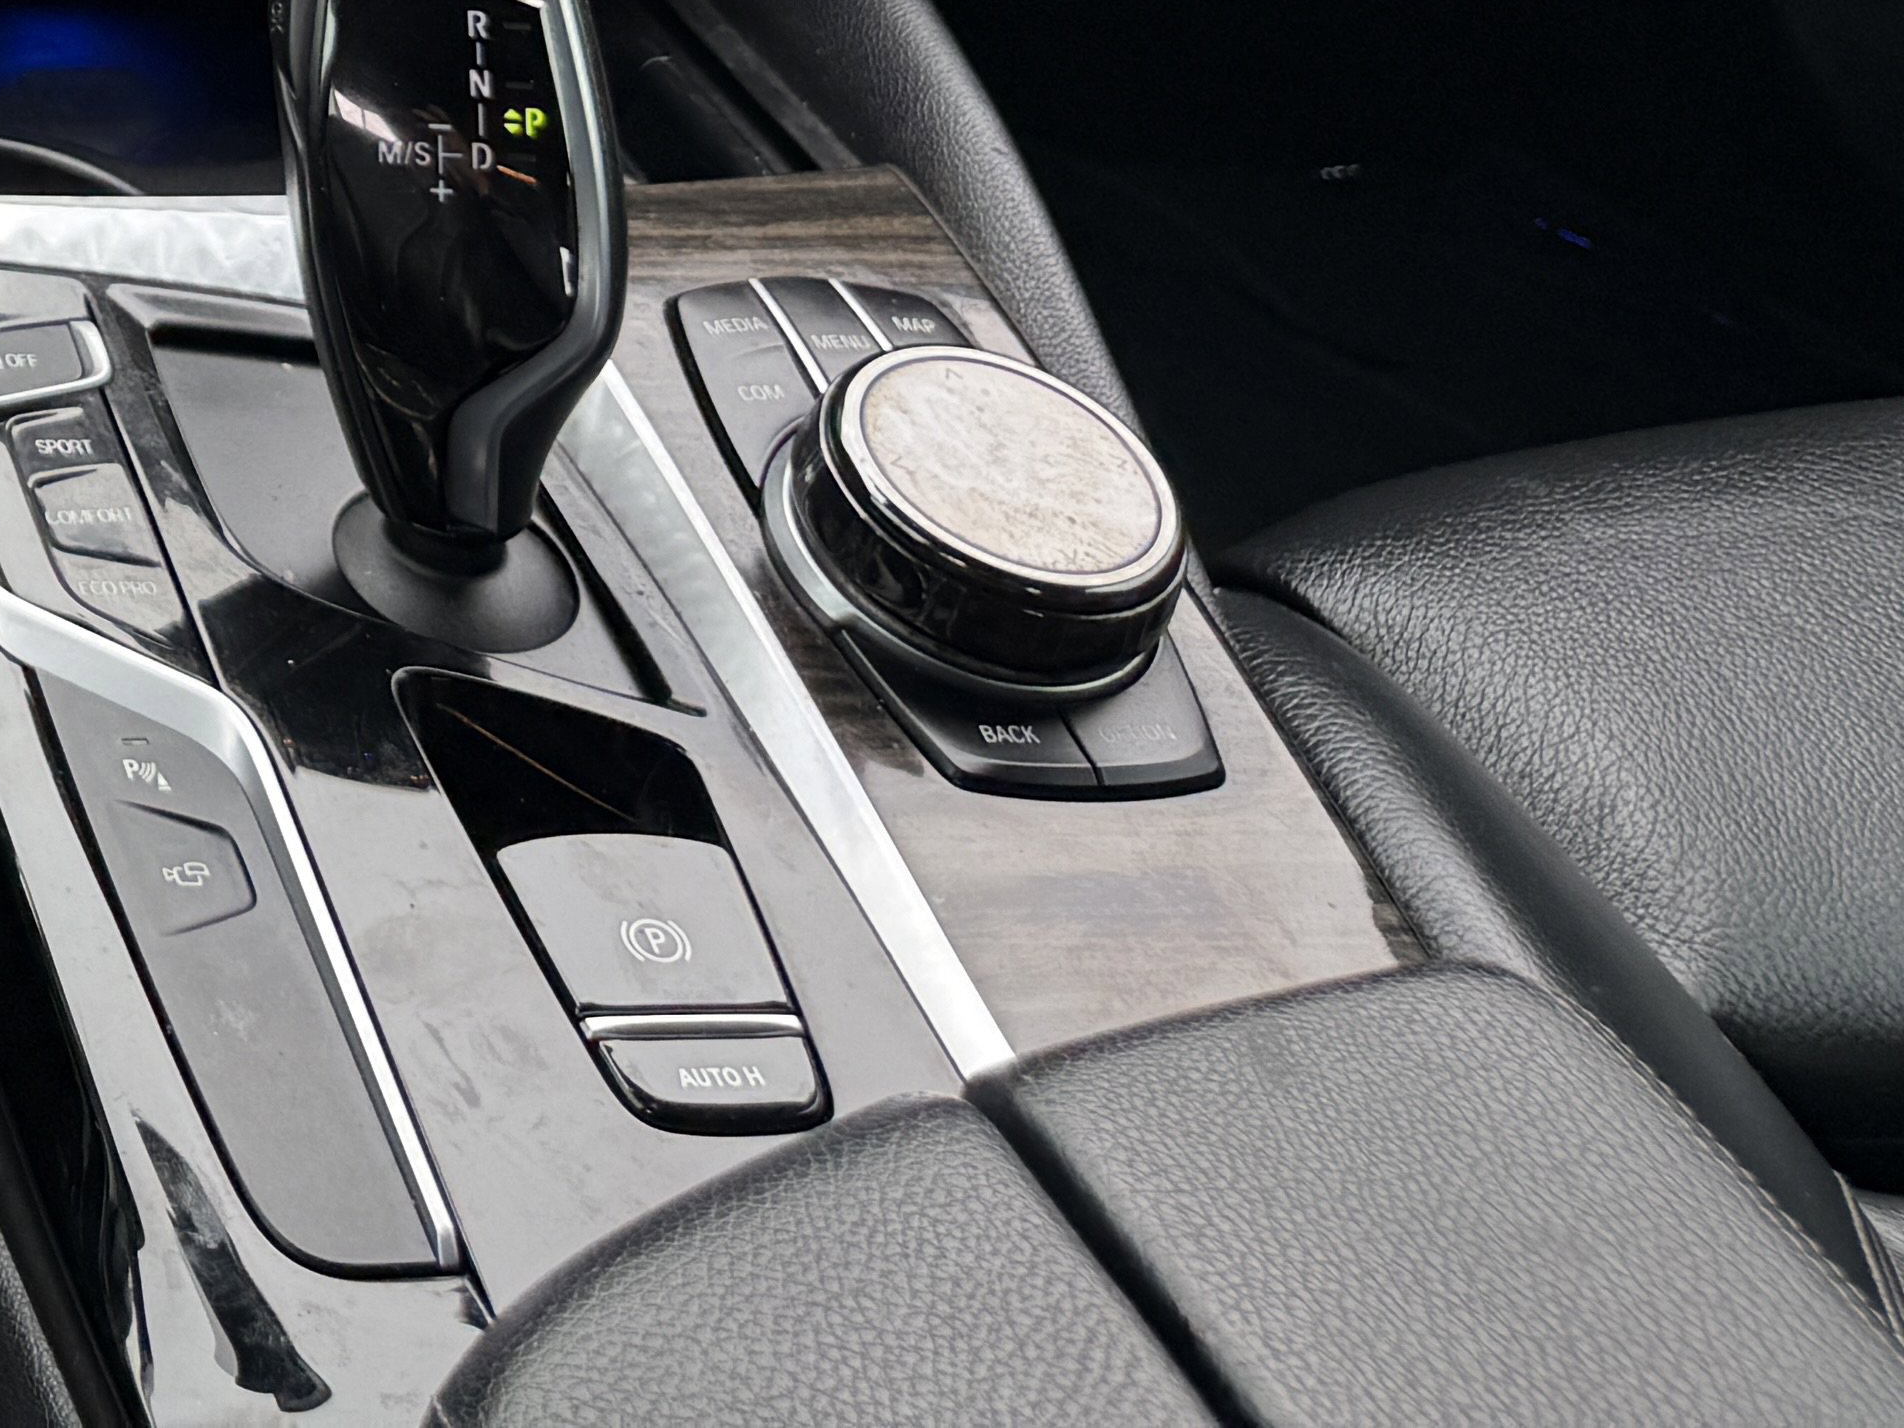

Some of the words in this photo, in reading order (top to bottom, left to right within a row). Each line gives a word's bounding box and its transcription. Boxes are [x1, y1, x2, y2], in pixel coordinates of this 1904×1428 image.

[467, 9, 491, 40] R
[469, 69, 492, 99] N
[524, 107, 549, 138] P
[378, 140, 432, 167] M/S
[471, 142, 493, 171] D
[702, 315, 769, 336] MEDIA
[890, 315, 936, 334] MAP
[810, 333, 871, 351] MENU
[4, 352, 39, 368] OFF
[737, 383, 785, 402] COM
[35, 438, 93, 455] SPORT
[44, 506, 134, 525] COMFORT
[78, 579, 119, 596] ECO
[120, 580, 158, 596] PRO
[978, 724, 1041, 744] BACK
[678, 1065, 742, 1088] AUTO
[743, 1065, 766, 1087] H
